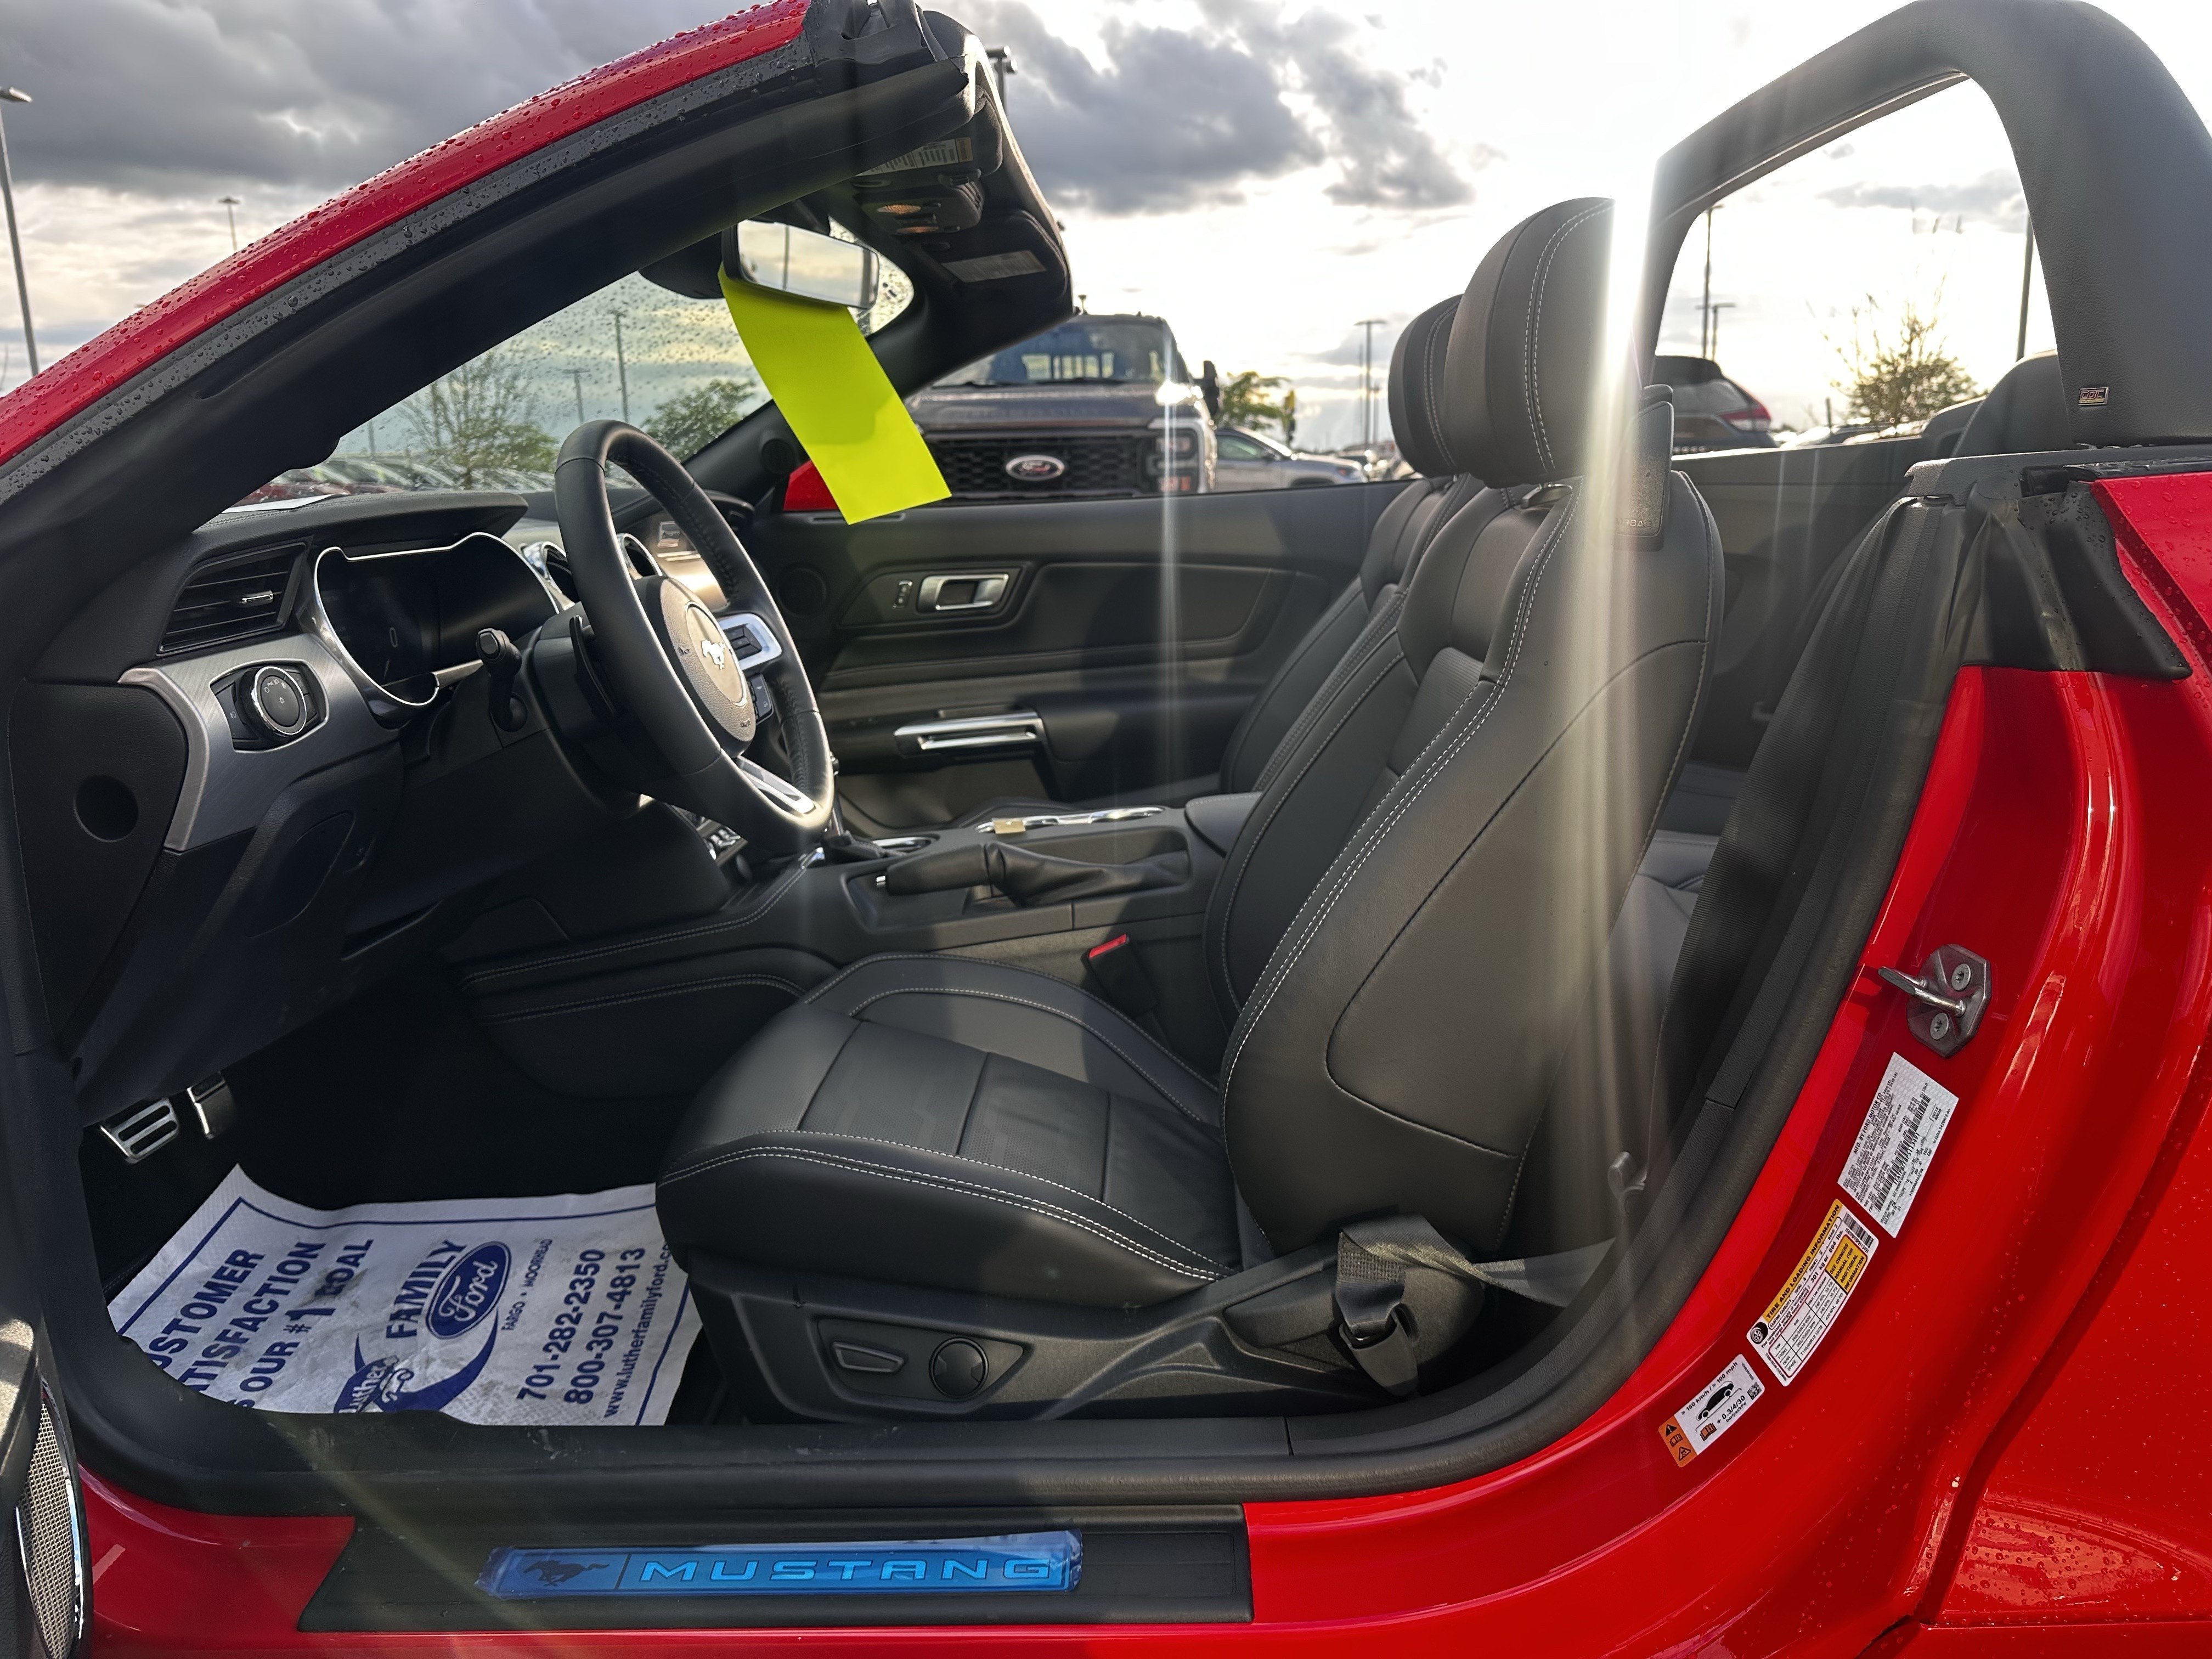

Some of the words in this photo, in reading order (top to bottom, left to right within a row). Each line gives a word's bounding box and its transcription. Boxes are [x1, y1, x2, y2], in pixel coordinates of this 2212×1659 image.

[1859, 1133, 1864, 1141] BY
[1862, 1118, 1871, 1133] FORD
[1868, 1099, 1878, 1119] MOTOR
[1766, 1301, 1779, 1320] TIRE
[1779, 1286, 1790, 1303] AND
[1788, 1255, 1812, 1287] LOADING
[1809, 1204, 1839, 1255] INFORMATION
[1810, 1271, 1819, 1283] 301
[1818, 1261, 1825, 1271] kg
[1827, 1240, 1837, 1253] 664
[1833, 1257, 1848, 1279] MANUAL
[1846, 1248, 1854, 1259] FOR
[1838, 1253, 1859, 1283] ADDITIONAL
[1842, 1255, 1866, 1290] INFORMATION
[386, 1240, 467, 1339] FAMILY
[439, 1261, 498, 1322] Ford
[516, 1249, 605, 1400] 701-282-2350
[563, 1248, 645, 1404] 800-307-4813
[240, 1341, 300, 1392] OUR
[284, 1307, 335, 1334] #1
[1695, 1389, 1709, 1403] km/h
[1716, 1373, 1726, 1384] 100
[1725, 1361, 1738, 1375] mph
[1720, 1395, 1746, 1420] 0.3/4/30
[640, 1559, 1051, 1582] MUSTANG
